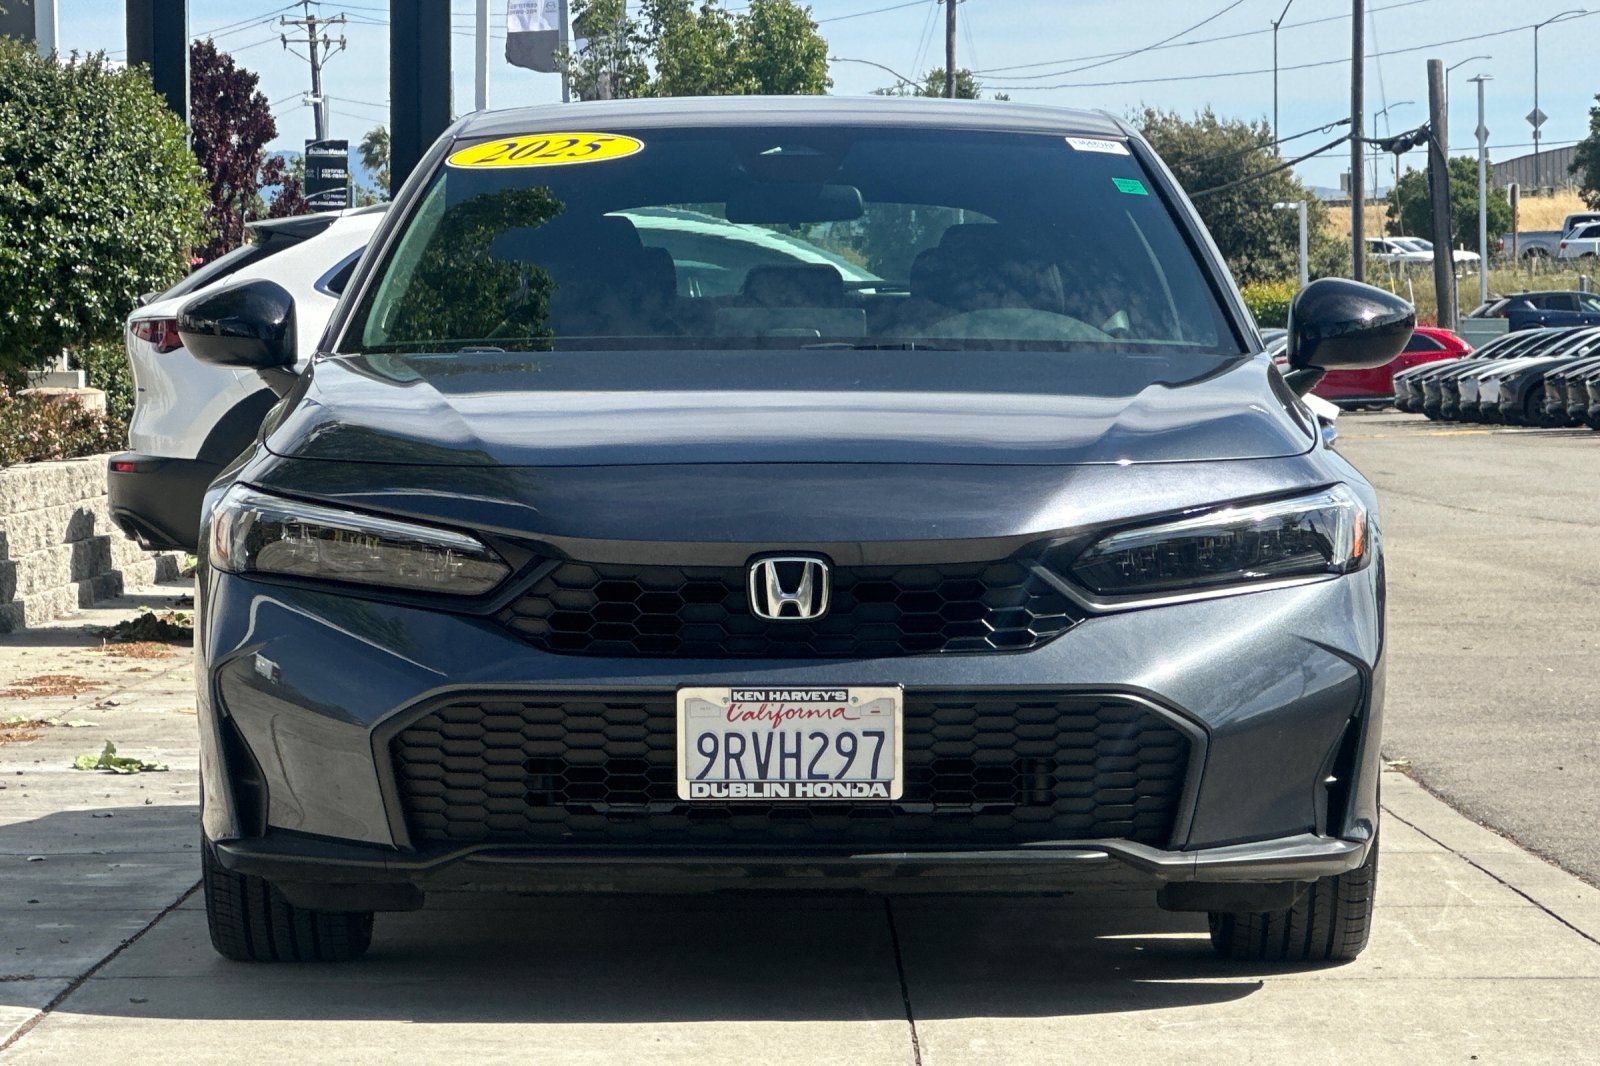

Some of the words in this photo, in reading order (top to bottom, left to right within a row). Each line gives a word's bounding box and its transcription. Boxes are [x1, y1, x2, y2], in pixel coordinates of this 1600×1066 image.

[471, 138, 615, 164] 2025
[732, 691, 765, 701] KEN
[769, 691, 847, 701] HARVEY'S
[727, 703, 861, 729] California
[696, 731, 885, 780] 9RVH297
[691, 783, 789, 798] DUBLIN
[795, 783, 889, 798] HONDA
